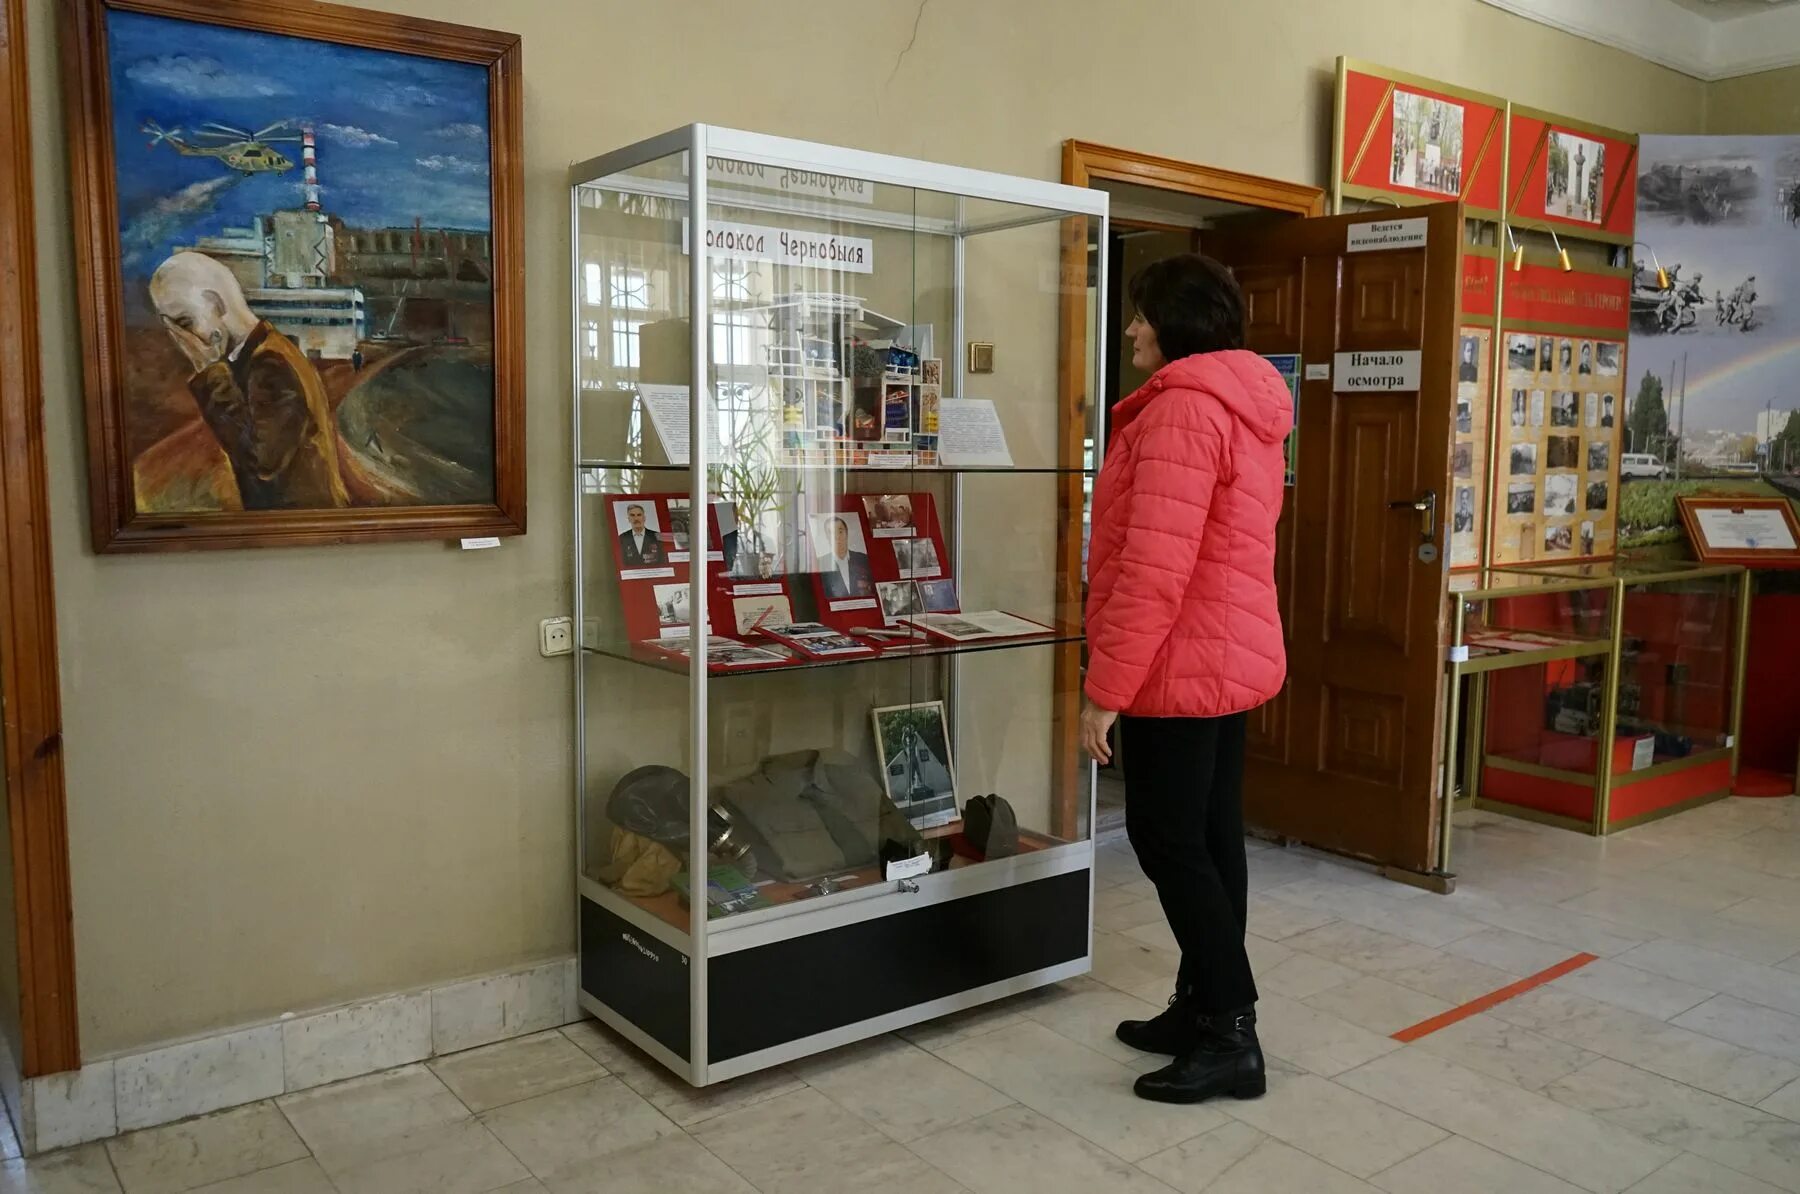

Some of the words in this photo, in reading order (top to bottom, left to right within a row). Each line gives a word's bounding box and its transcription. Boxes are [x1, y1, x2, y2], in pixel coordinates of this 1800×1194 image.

[706, 230, 764, 253] олокол
[780, 231, 864, 264] Чернобыля
[1351, 234, 1424, 246] видеонаблюдение
[1351, 353, 1404, 367] Начало
[1348, 375, 1405, 390] осмотра
